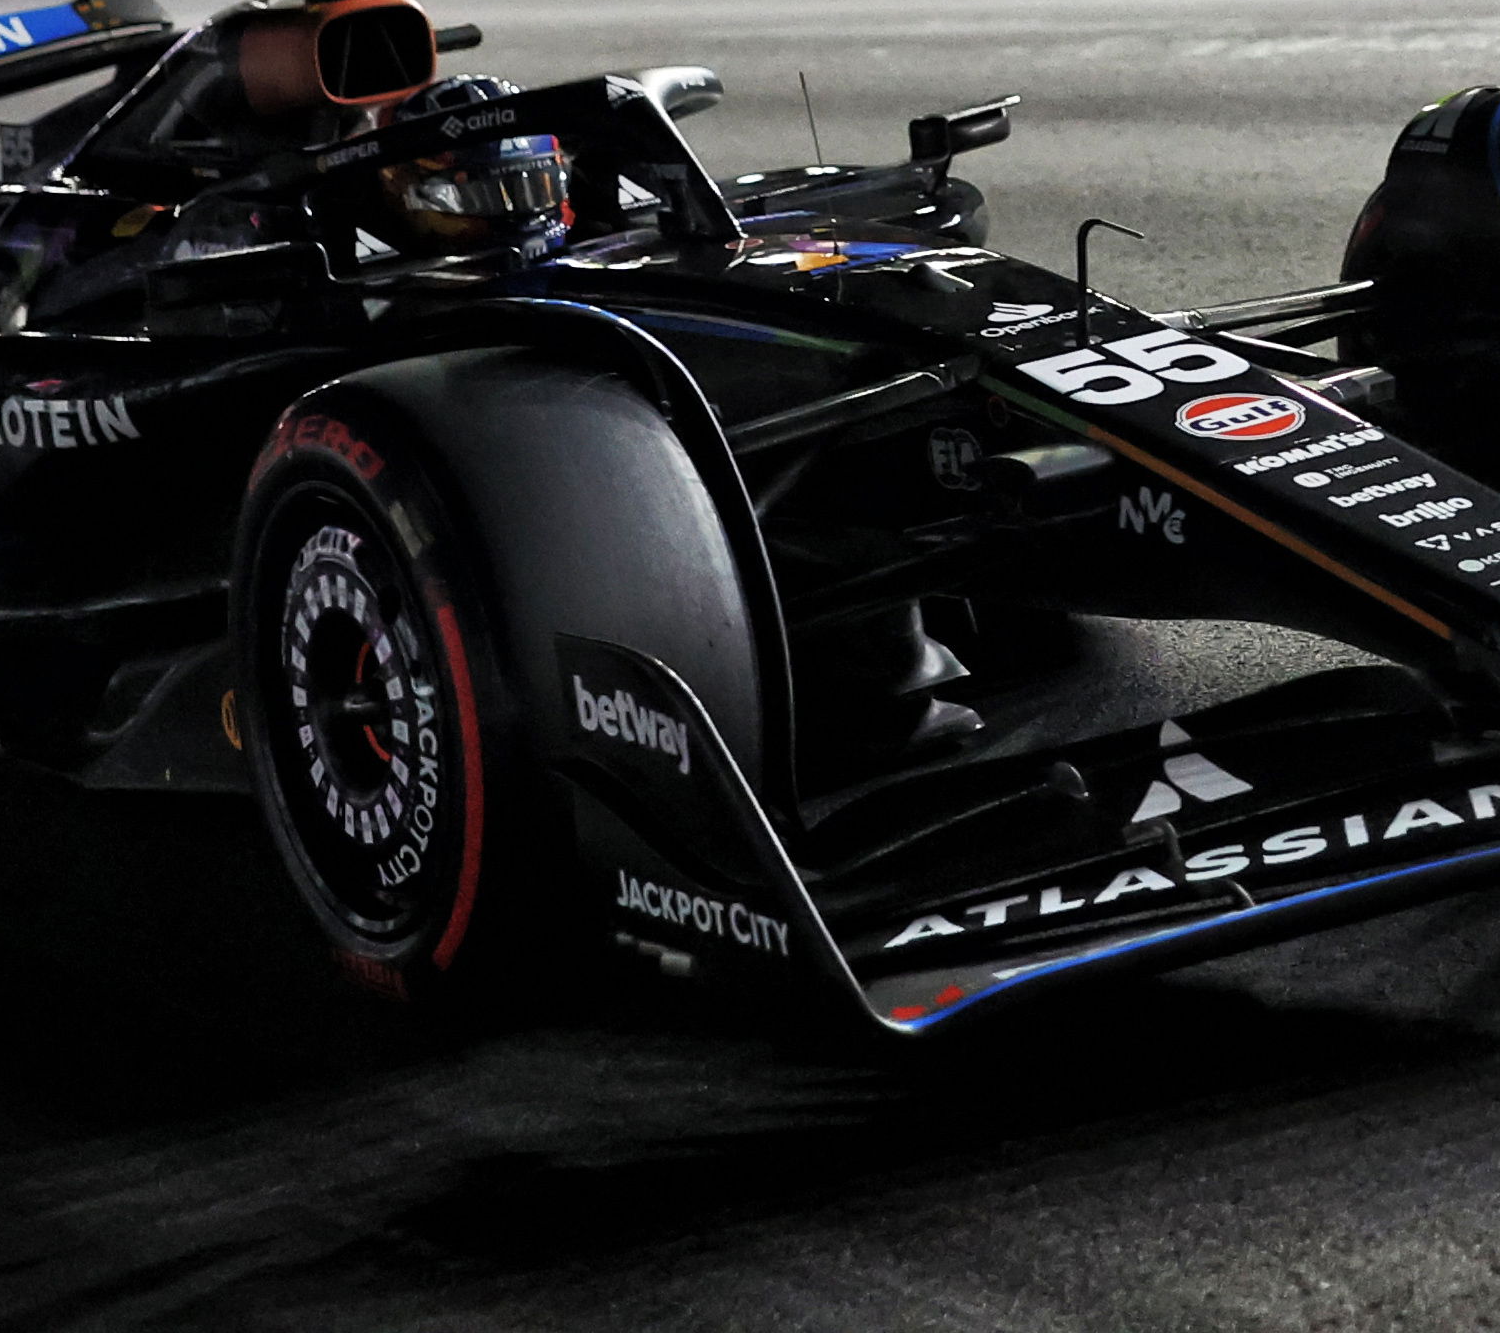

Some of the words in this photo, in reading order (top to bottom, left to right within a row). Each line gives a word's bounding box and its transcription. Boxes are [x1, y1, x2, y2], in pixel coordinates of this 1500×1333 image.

[1015, 328, 1251, 406] 55
[1189, 400, 1291, 432] Gulf
[1327, 471, 1438, 510] betway
[1378, 496, 1474, 530] brillio
[572, 674, 691, 776] betway
[409, 676, 440, 854] JACKPOT
[616, 868, 725, 937] JACKPOT
[727, 901, 790, 958] CITY
